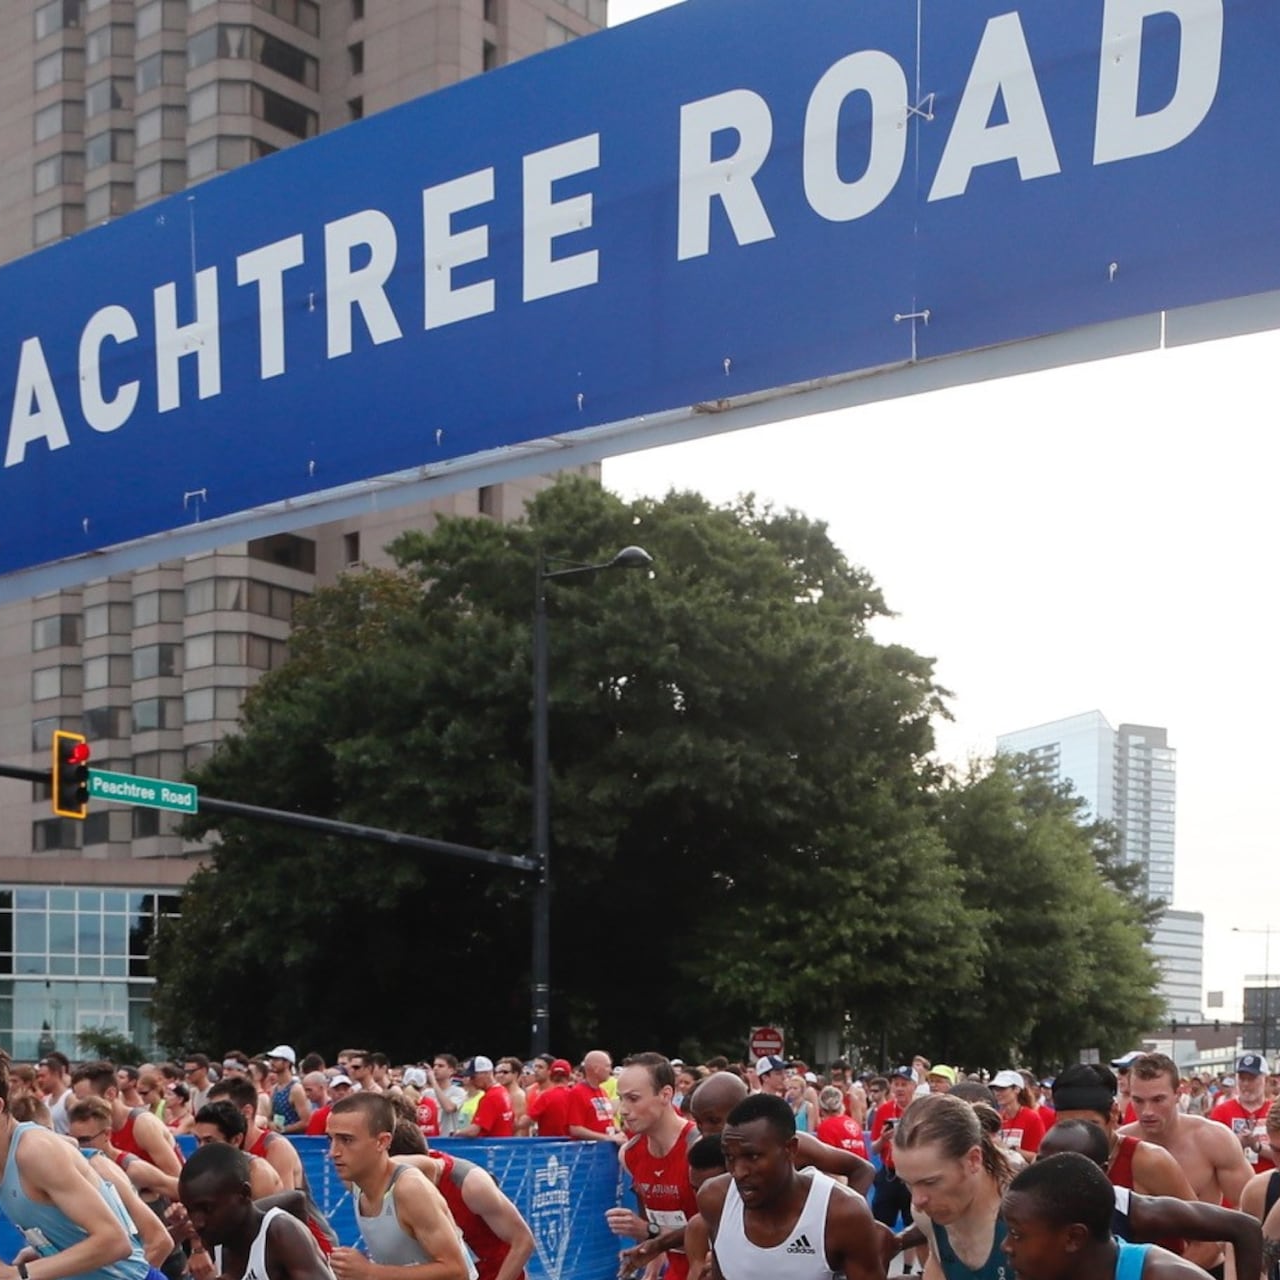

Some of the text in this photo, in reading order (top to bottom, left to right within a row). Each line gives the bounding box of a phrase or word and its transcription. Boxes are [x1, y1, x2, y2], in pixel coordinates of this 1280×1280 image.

[678, 0, 1222, 262] ROAD
[93, 777, 192, 806] Peachtree Road
[786, 1247, 816, 1255] adidas
